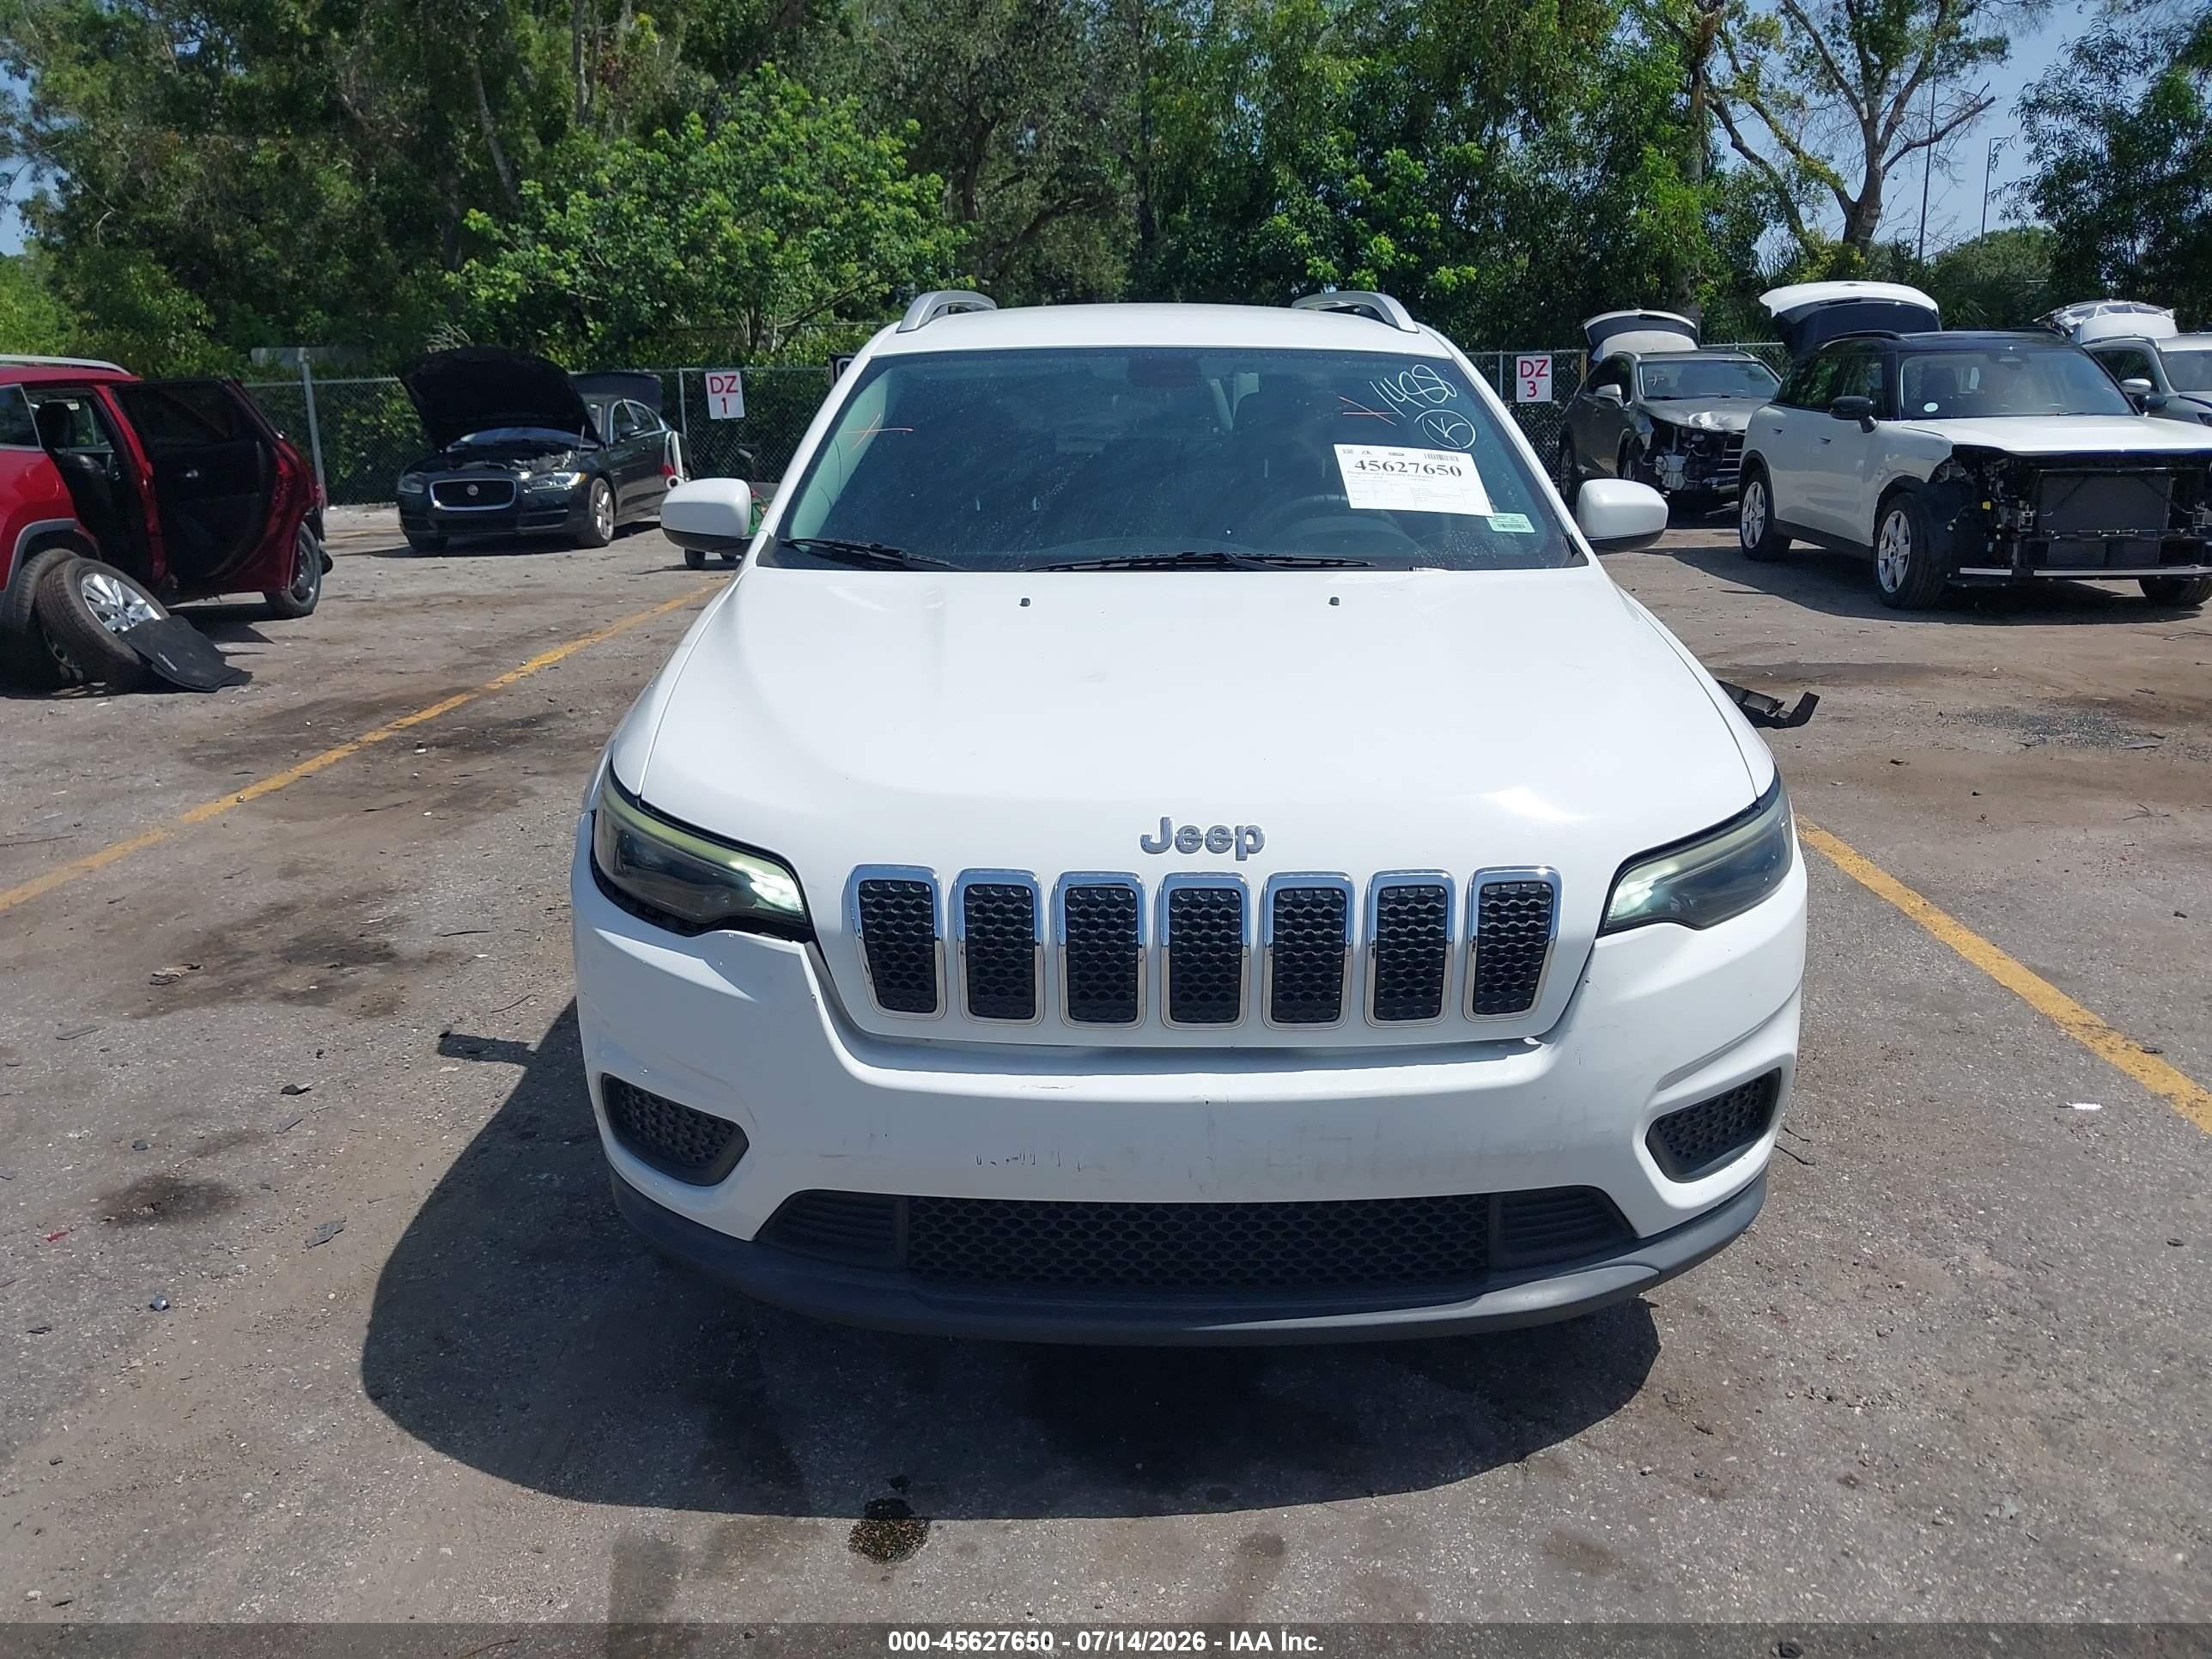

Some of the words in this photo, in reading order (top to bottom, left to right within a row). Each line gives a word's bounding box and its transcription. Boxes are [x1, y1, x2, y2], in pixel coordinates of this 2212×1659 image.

[1520, 359, 1548, 379] DZ
[710, 375, 738, 394] DZ
[1527, 380, 1537, 398] 3
[721, 397, 728, 415] 1
[1354, 459, 1462, 477] 45627650
[1139, 817, 1266, 861] Jeep
